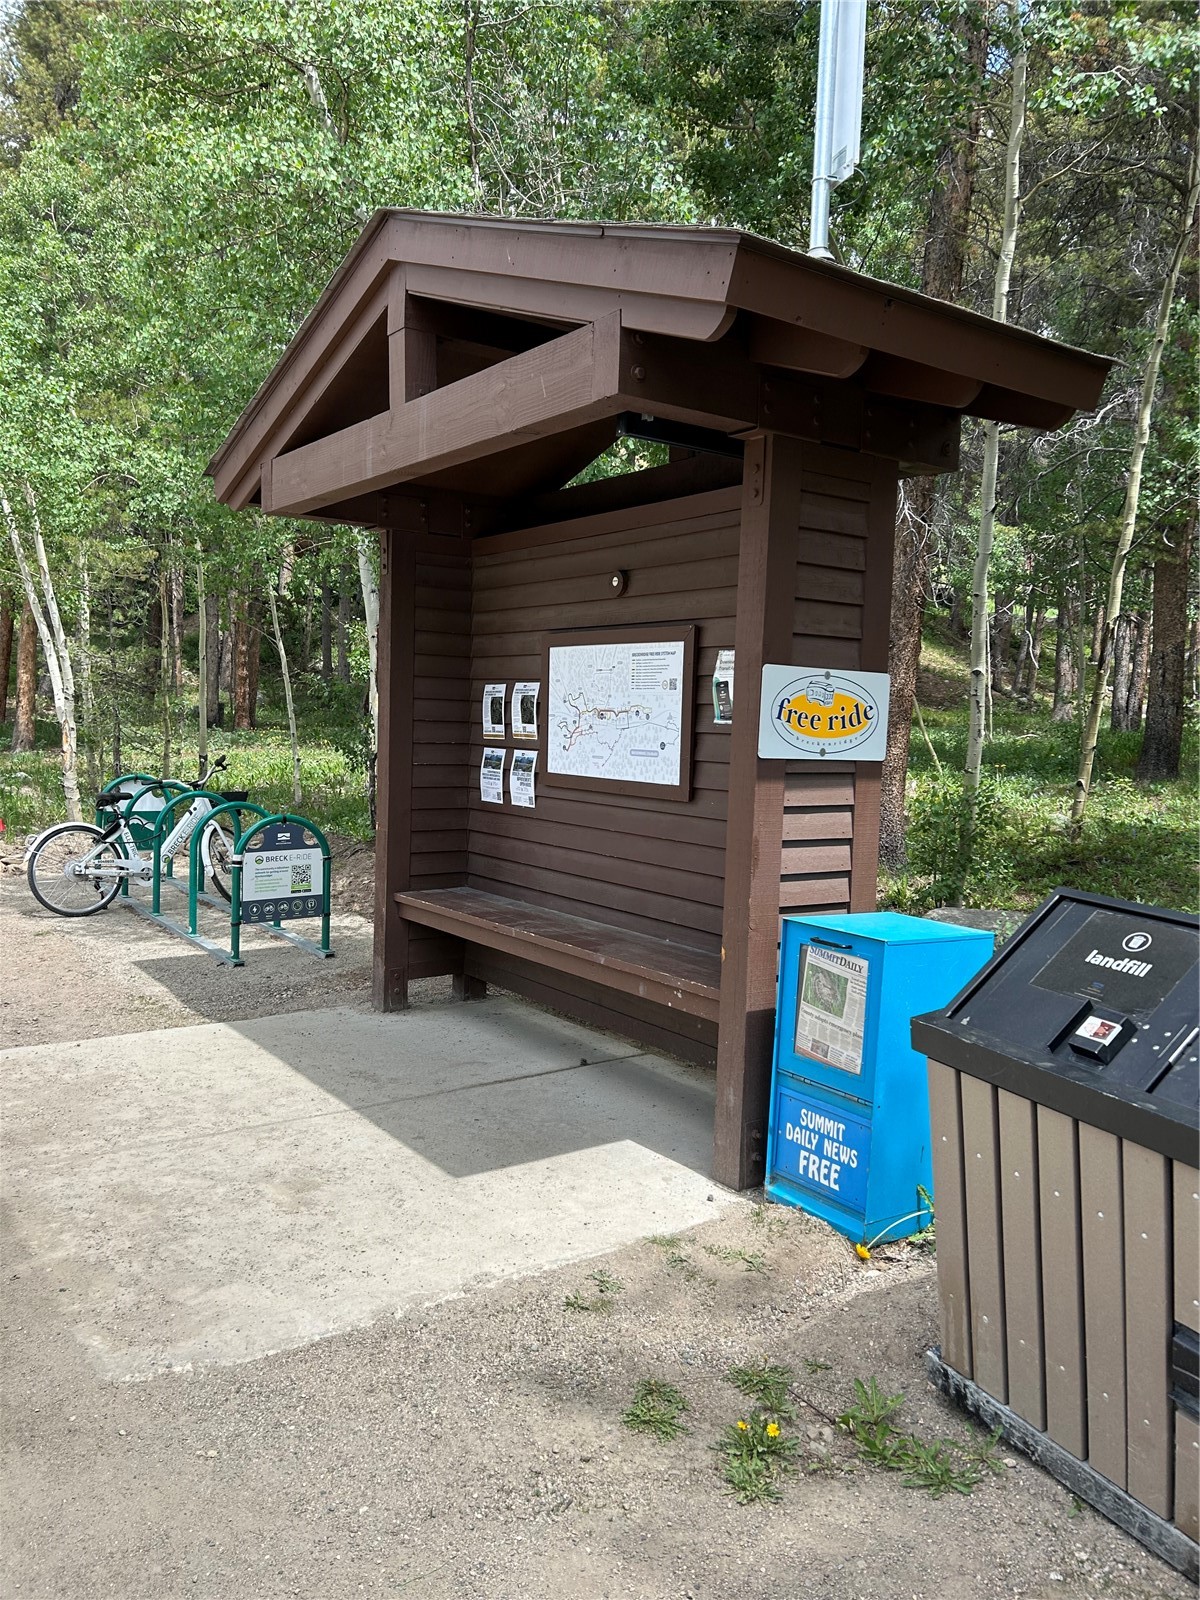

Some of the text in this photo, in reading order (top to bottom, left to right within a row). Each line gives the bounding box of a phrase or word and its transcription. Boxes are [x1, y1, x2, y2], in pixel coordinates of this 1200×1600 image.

[775, 697, 876, 731] free ride
[123, 831, 139, 858] ELETRIC
[167, 834, 186, 855] BRECK
[265, 854, 289, 863] BRECK
[1084, 949, 1153, 978] landfill
[800, 1108, 846, 1142] SUMMIT
[785, 1122, 858, 1169] DAILY NEWS
[798, 1149, 841, 1191] FREE
